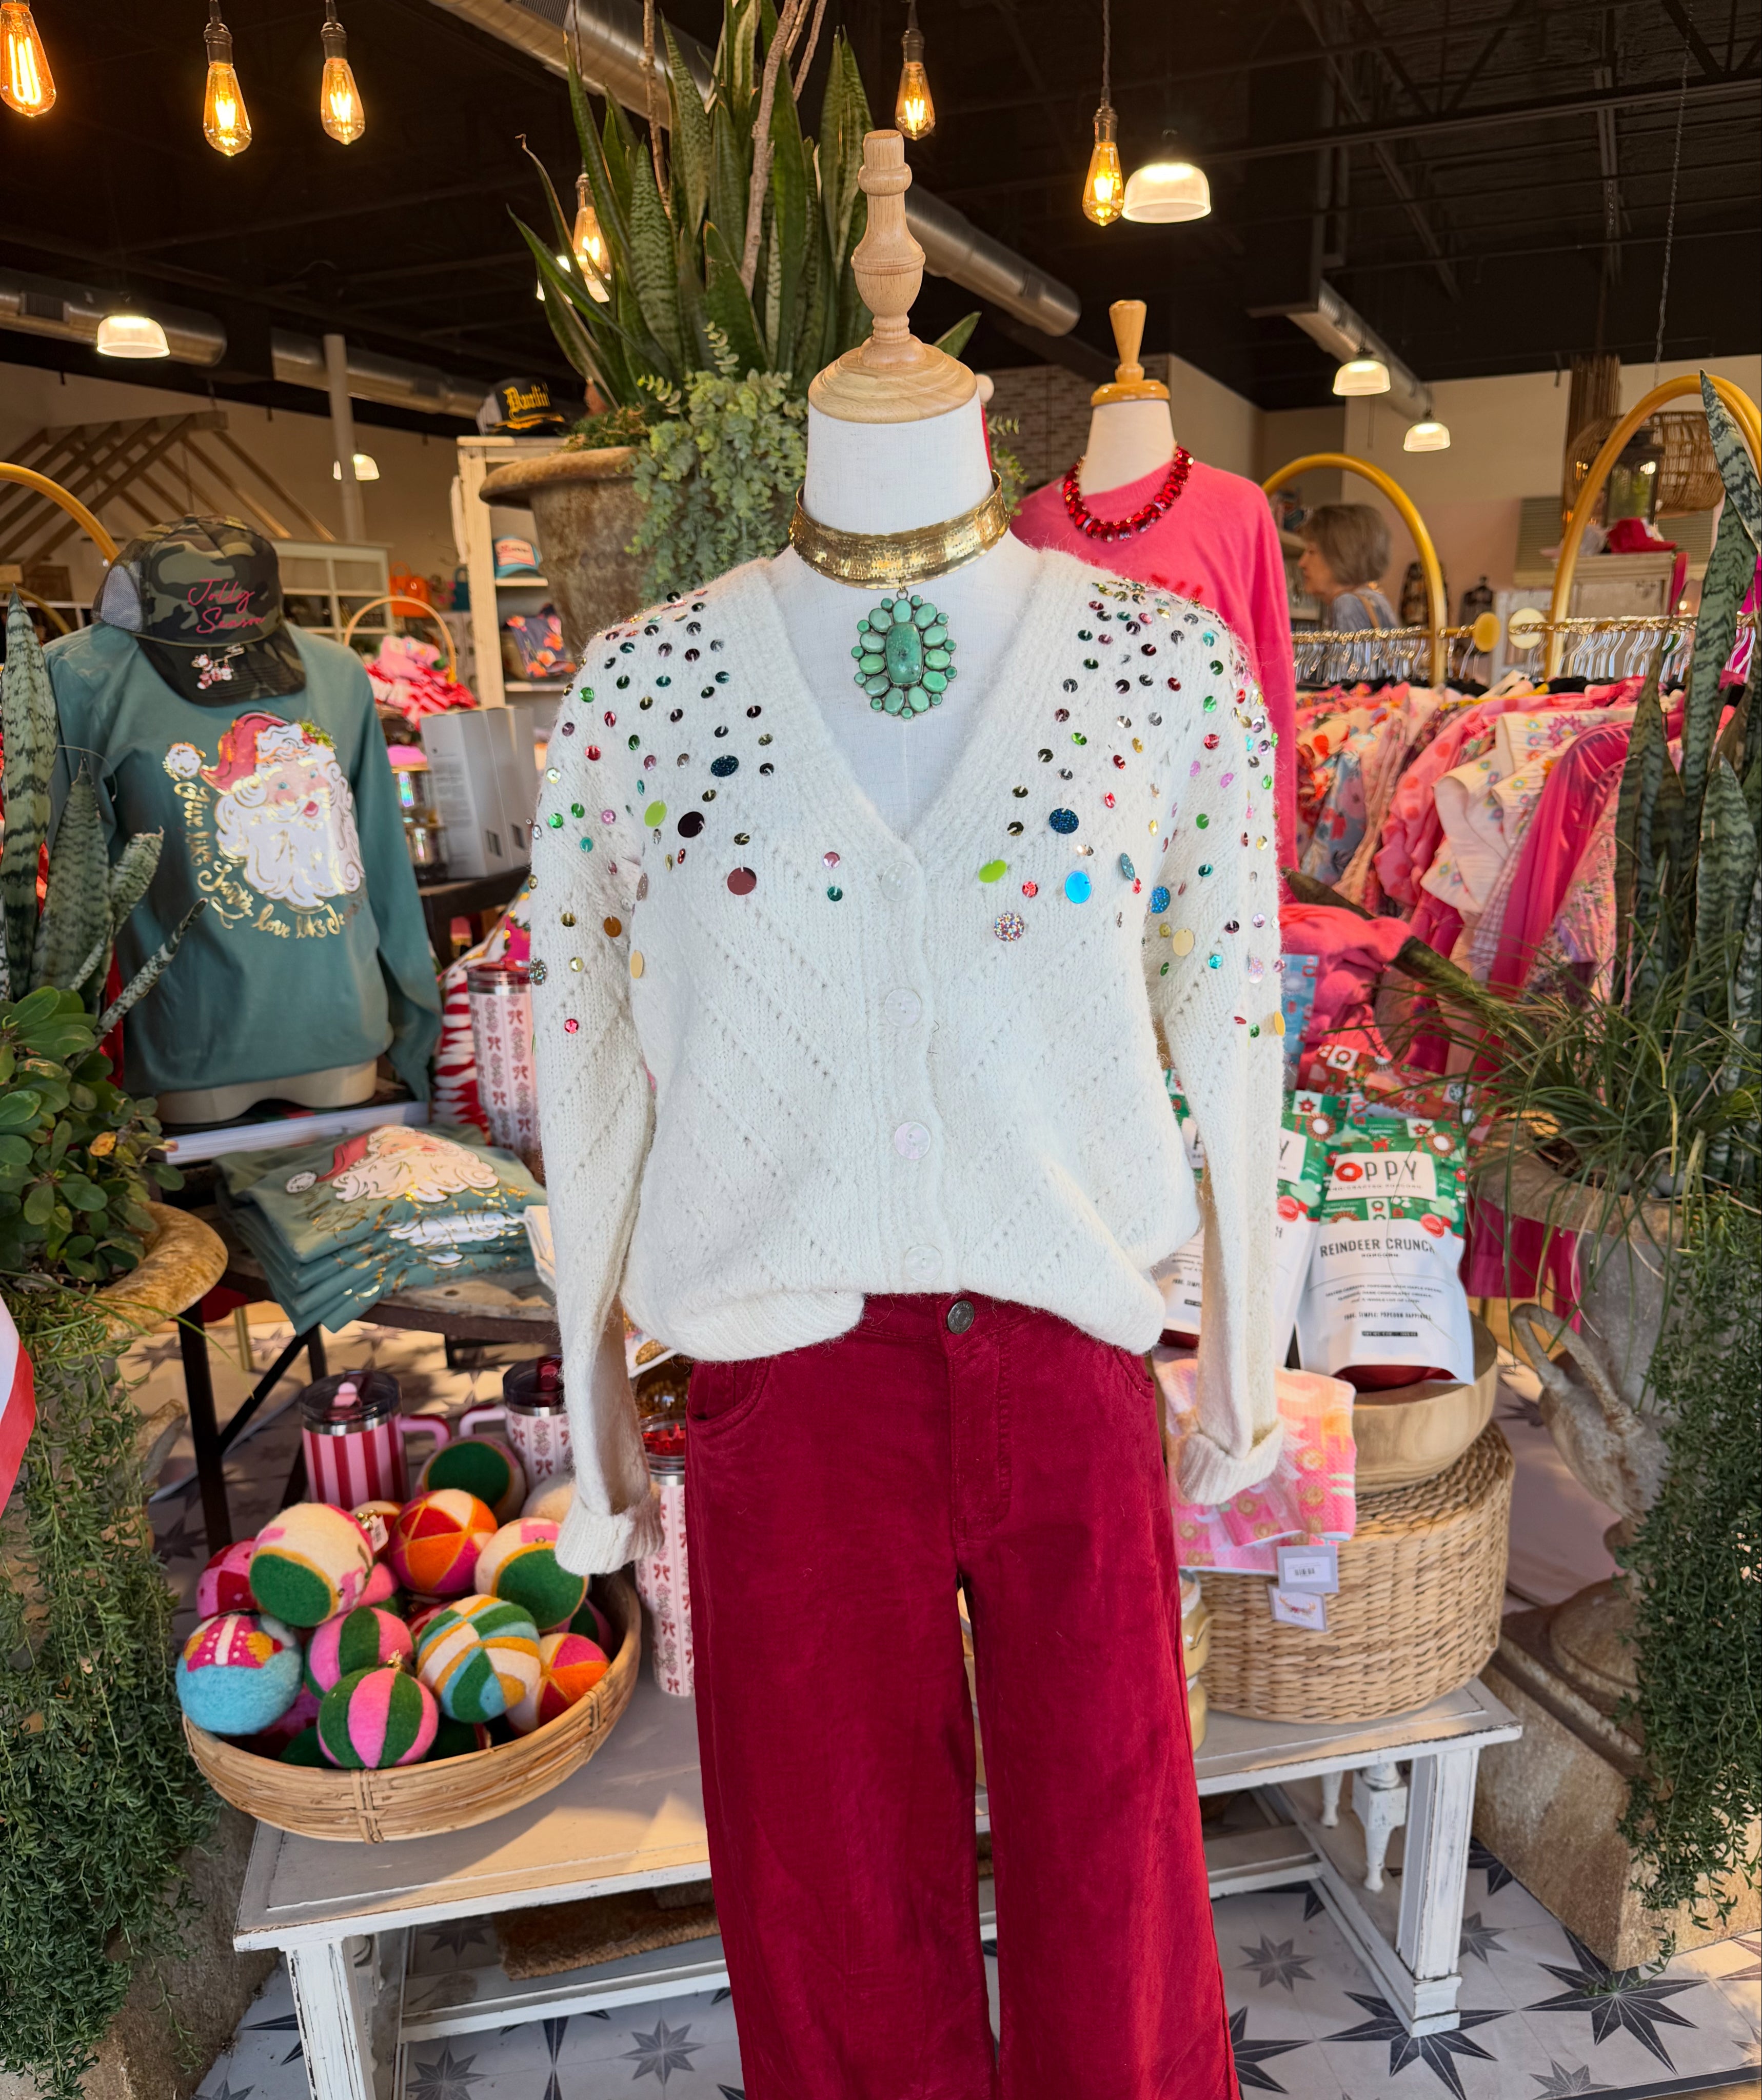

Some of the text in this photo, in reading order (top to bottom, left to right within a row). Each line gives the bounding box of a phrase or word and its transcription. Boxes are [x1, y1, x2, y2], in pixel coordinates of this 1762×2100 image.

[188, 578, 255, 614] Jolly
[196, 607, 266, 634] Season
[251, 903, 291, 938] love
[1320, 1238, 1381, 1258] REINDEER
